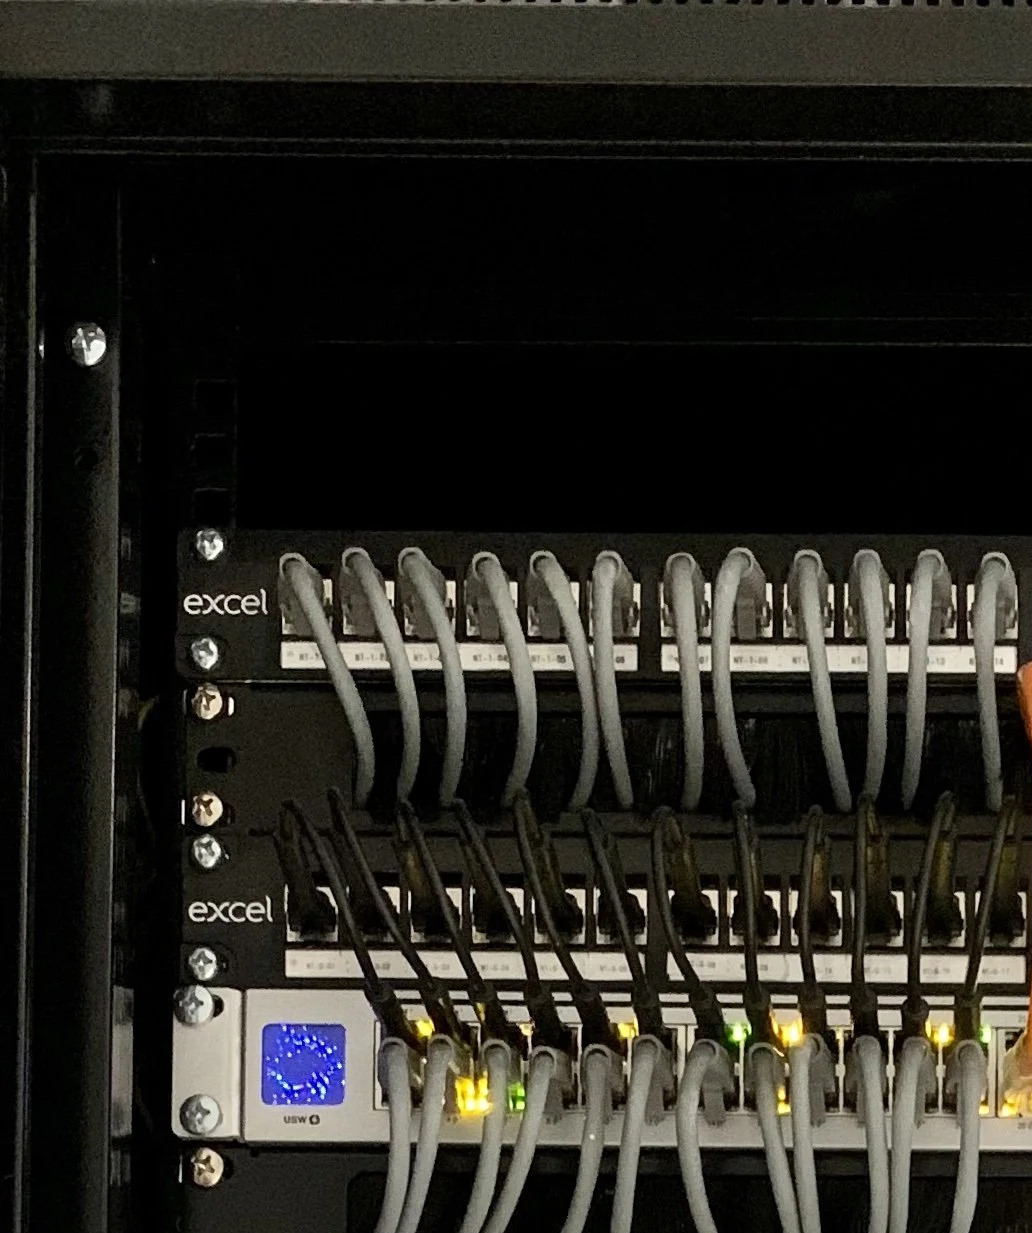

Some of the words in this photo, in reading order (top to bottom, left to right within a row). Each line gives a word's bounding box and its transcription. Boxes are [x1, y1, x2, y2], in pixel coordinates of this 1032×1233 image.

[183, 588, 268, 615] excel
[188, 895, 274, 923] excel
[283, 1115, 308, 1124] USW
